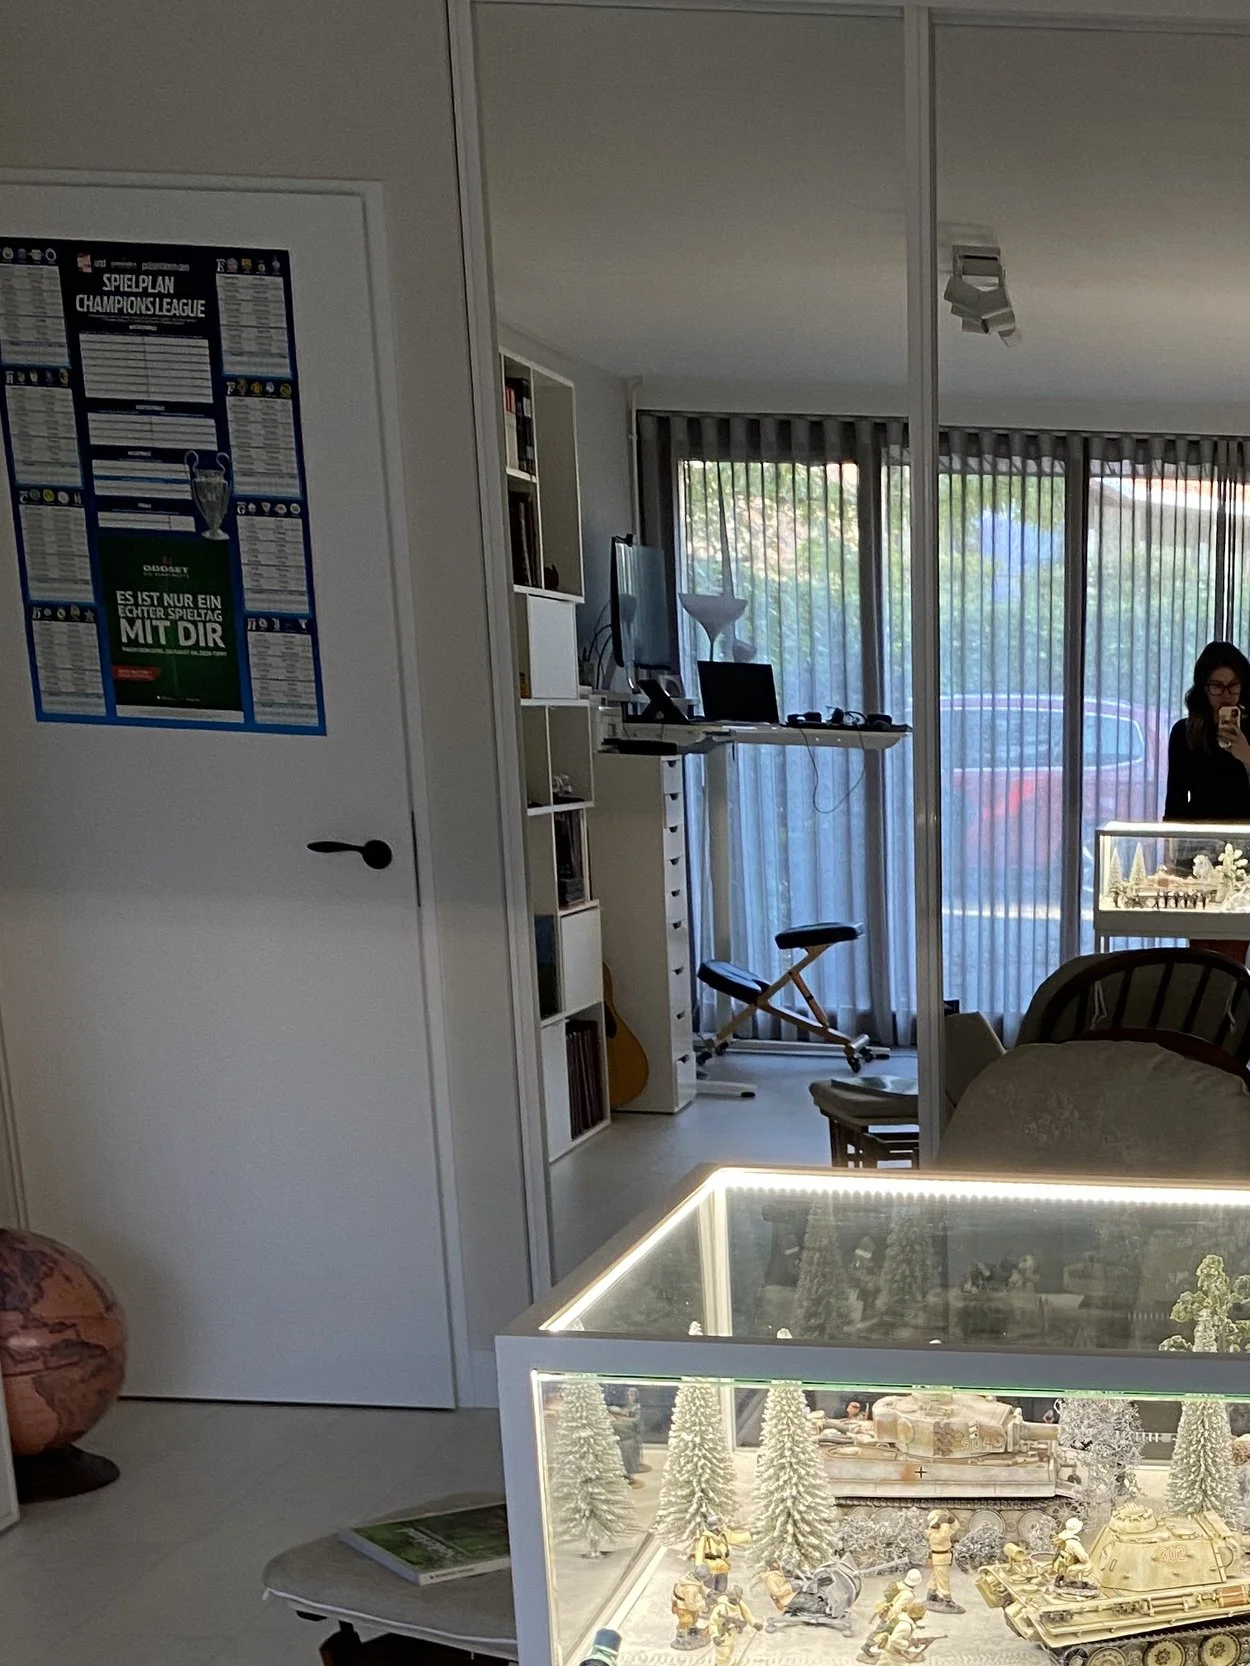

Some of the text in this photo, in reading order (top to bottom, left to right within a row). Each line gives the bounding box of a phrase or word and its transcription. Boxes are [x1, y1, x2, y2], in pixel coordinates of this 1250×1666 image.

[102, 273, 175, 294] SPIELPLAN
[75, 294, 206, 318] CHAMPIONS LEAGUE
[116, 590, 222, 609] ES IST NUR EIN
[118, 605, 223, 622] ECHTER SPIELTAG
[120, 618, 171, 645] MIT
[177, 621, 226, 648] DIR
